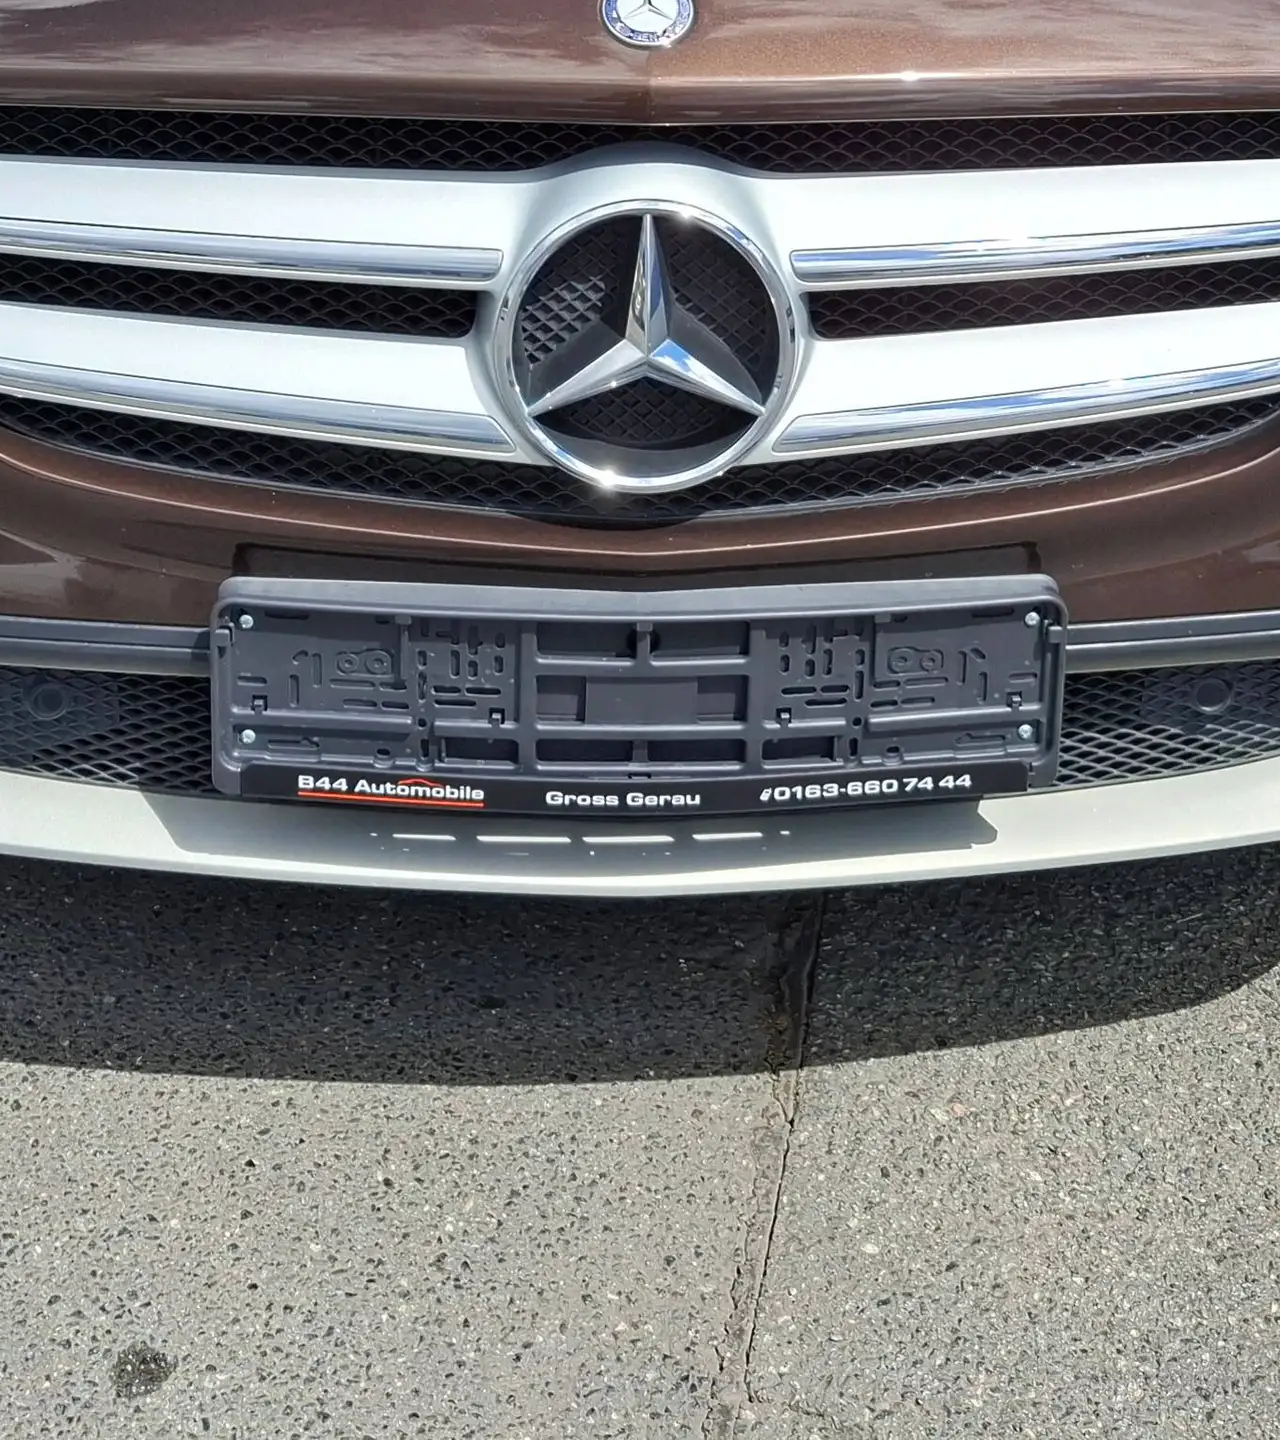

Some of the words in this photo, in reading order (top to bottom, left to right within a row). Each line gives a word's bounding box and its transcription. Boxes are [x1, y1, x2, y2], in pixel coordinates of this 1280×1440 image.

[298, 774, 349, 792] B44
[354, 781, 485, 801] Automobile
[545, 790, 620, 806] Gross
[626, 792, 701, 807] Gerau
